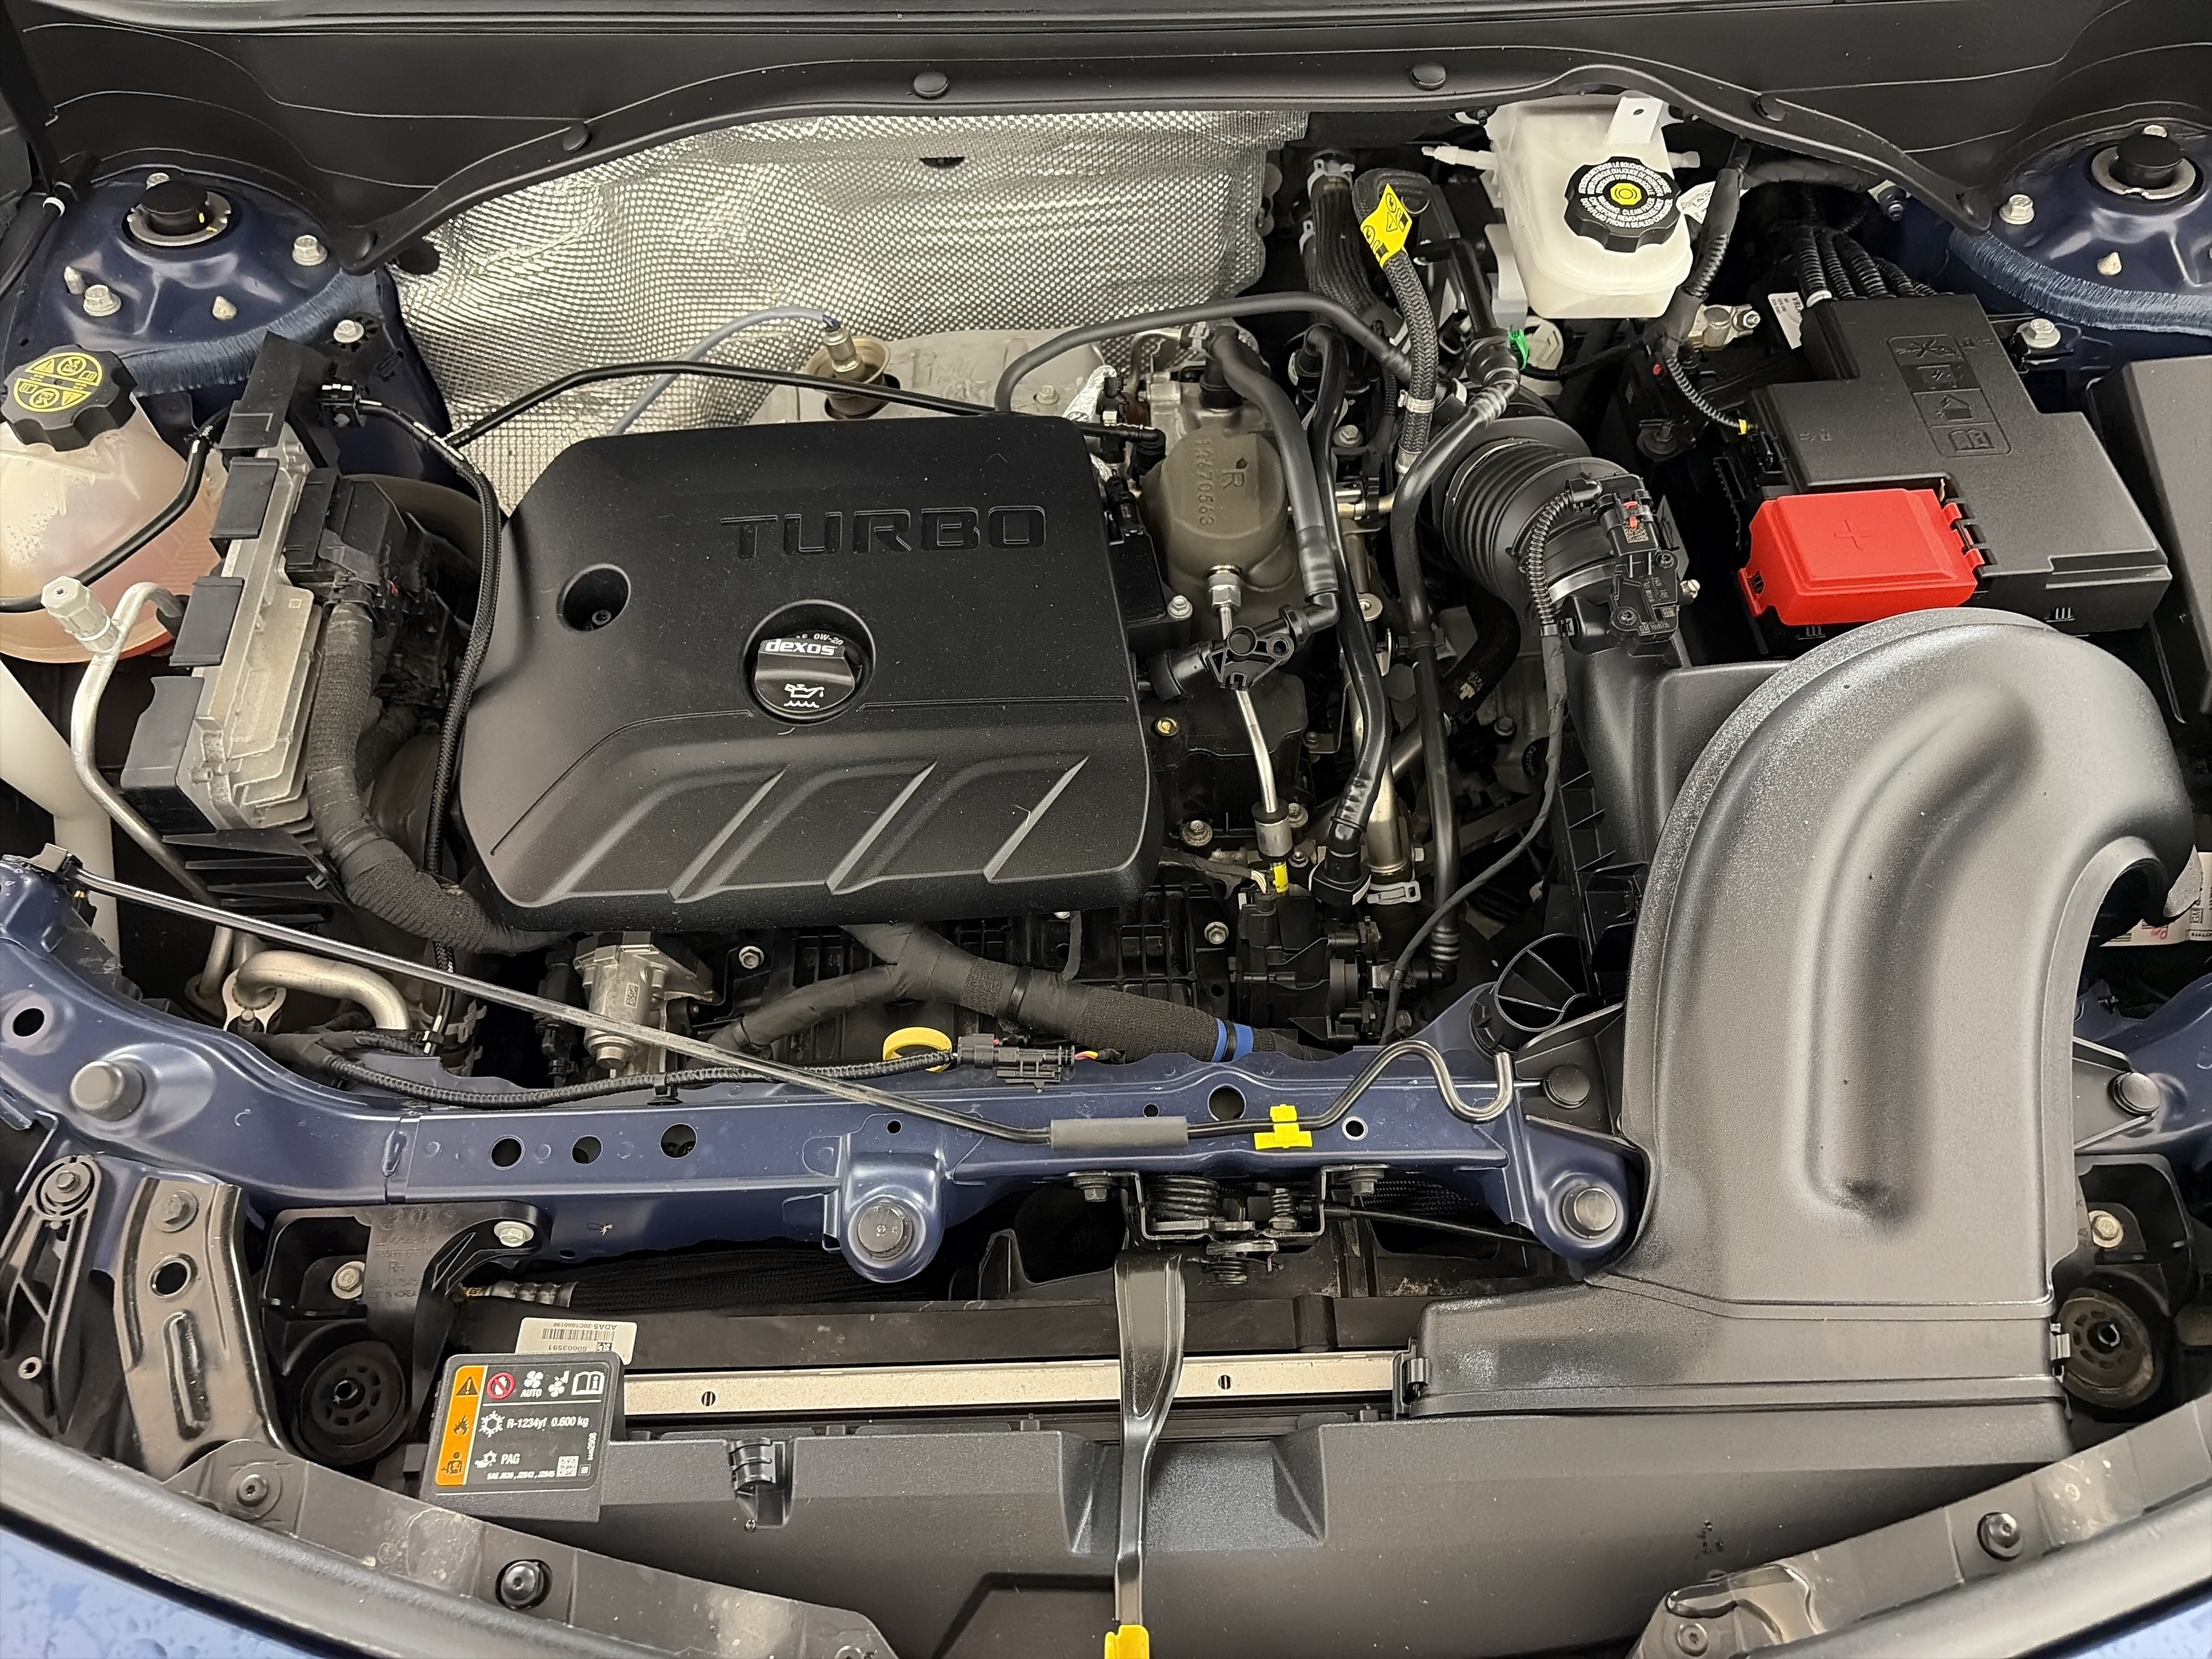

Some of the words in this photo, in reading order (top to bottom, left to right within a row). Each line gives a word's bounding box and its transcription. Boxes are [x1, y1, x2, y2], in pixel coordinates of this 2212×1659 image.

[1620, 161, 1647, 171] BOUCHON
[1643, 166, 1661, 179] AVANT
[1589, 208, 1606, 221] FLUID
[1605, 217, 1624, 227] FROM
[1630, 218, 1654, 228] SEALED
[1595, 205, 1617, 219] BEFORE
[721, 506, 1046, 559] TURBO
[765, 639, 836, 656] dexos
[520, 1389, 543, 1398] AUTO
[506, 1417, 548, 1430] R-1234yf
[551, 1417, 577, 1427] 0.600
[578, 1416, 589, 1427] kg
[500, 1453, 521, 1465] PAG
